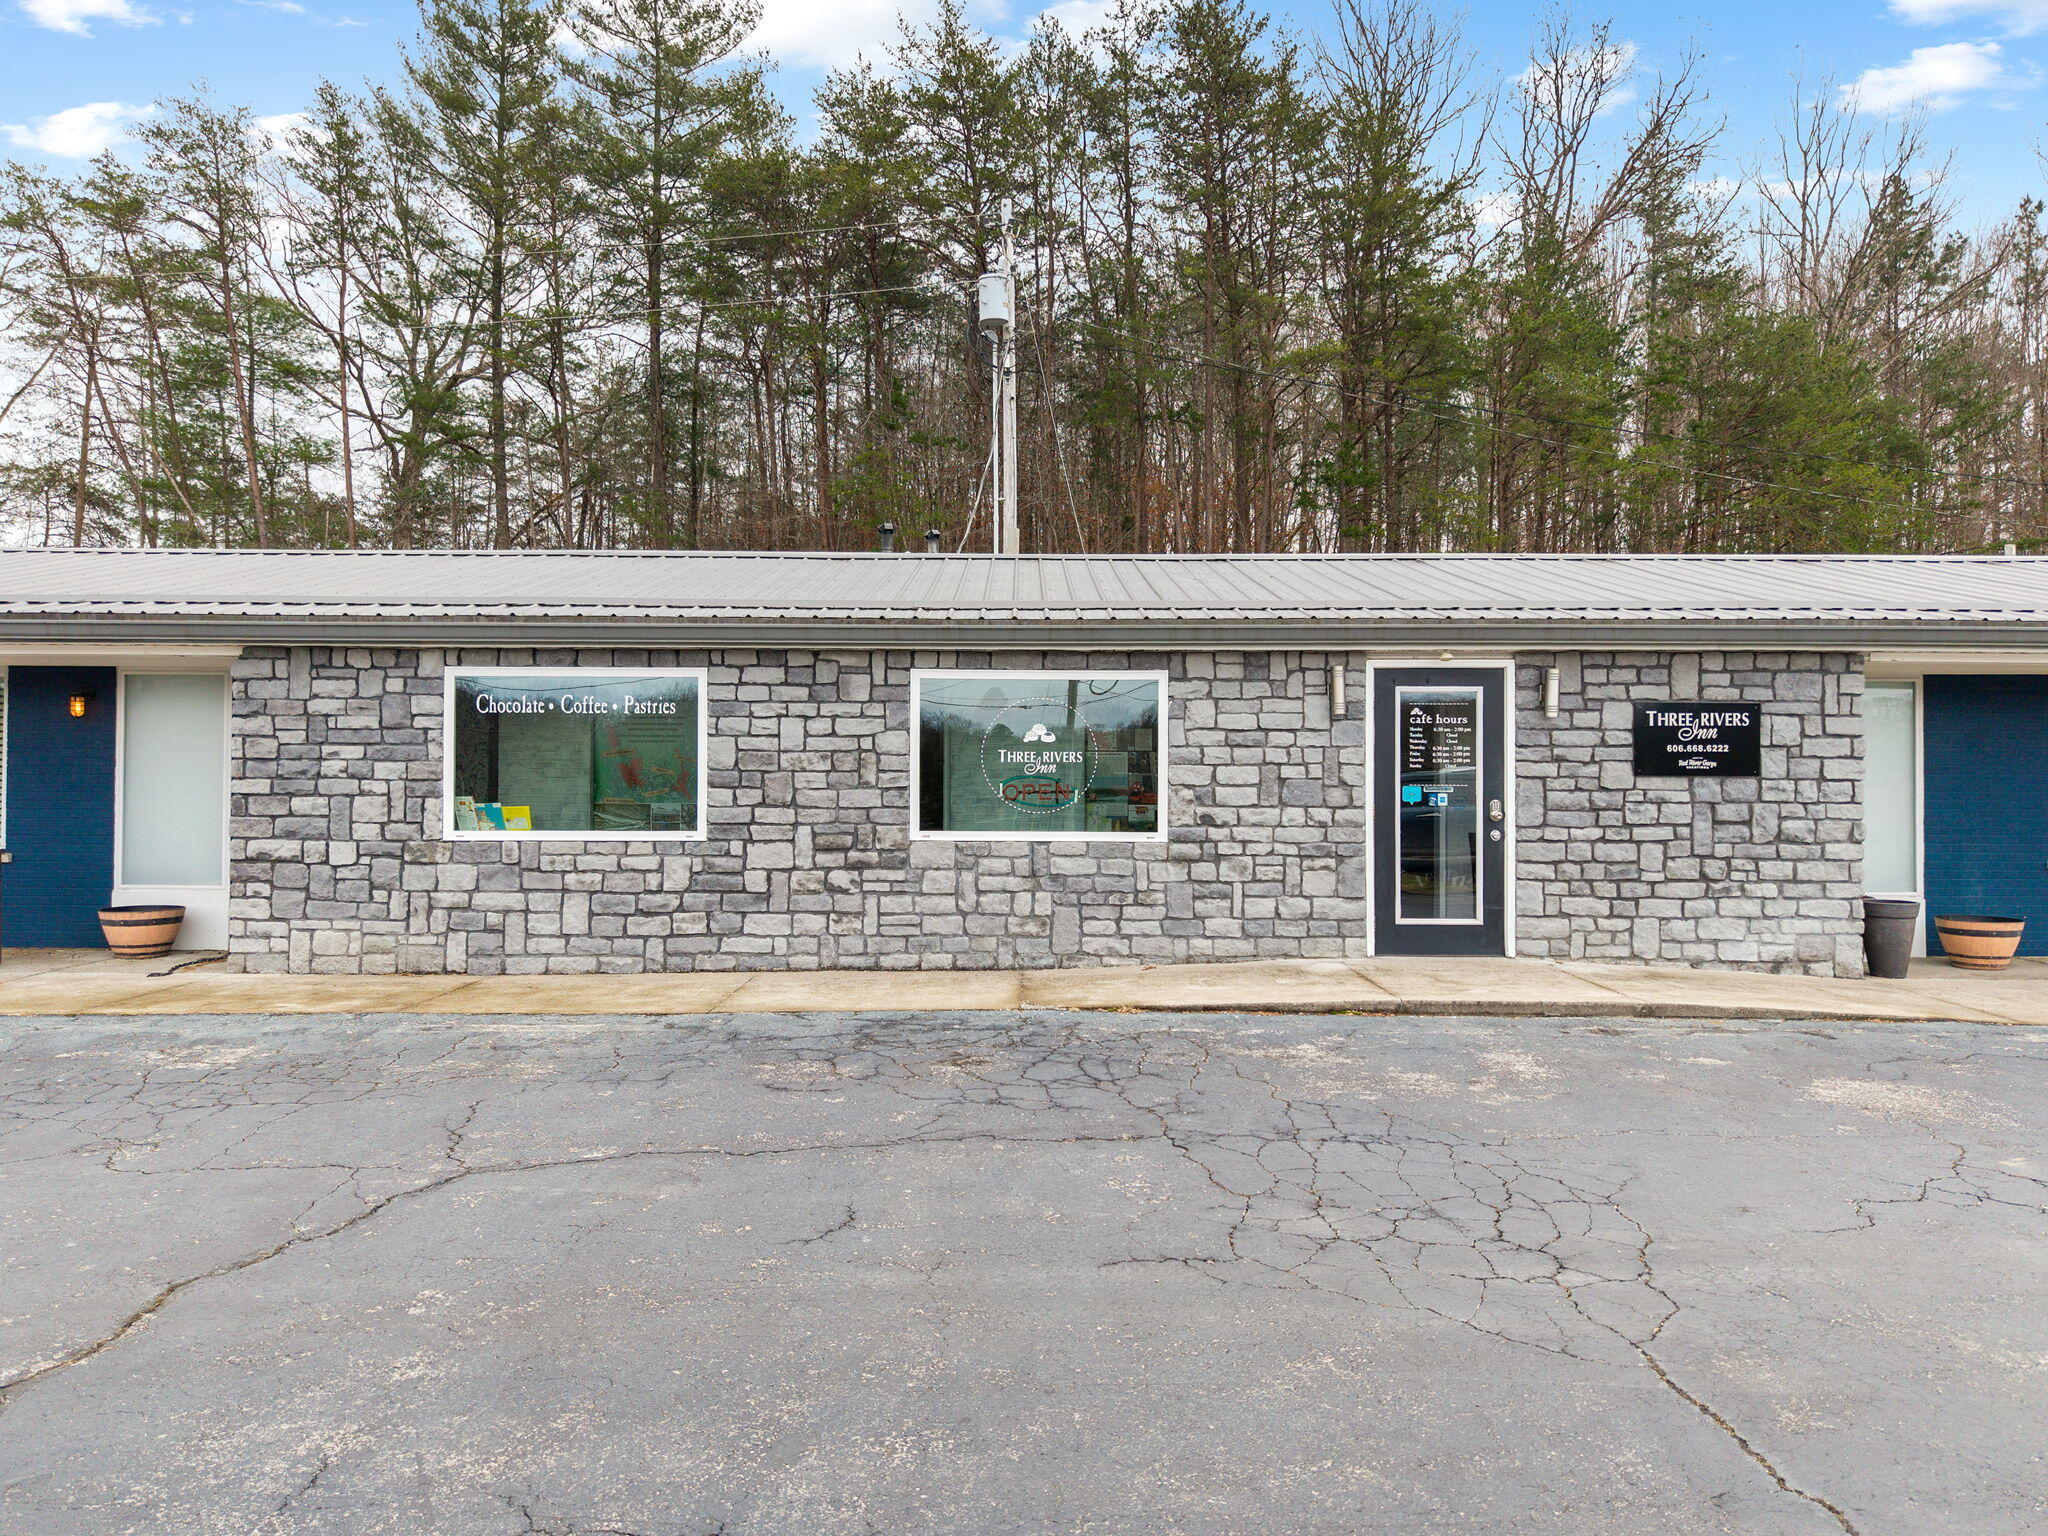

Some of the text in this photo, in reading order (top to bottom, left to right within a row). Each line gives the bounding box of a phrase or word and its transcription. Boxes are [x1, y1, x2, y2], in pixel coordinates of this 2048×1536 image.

[476, 694, 676, 714] Chocolate Coffee Pastries
[1435, 714, 1468, 724] hours
[1646, 710, 1750, 727] THREE RIVERS
[1678, 718, 1718, 741] Inn
[998, 749, 1083, 763] THREE RIVERS
[1666, 744, 1729, 753] 606.668.6222
[1024, 756, 1057, 775] Inn
[1003, 783, 1071, 801] OPEN
